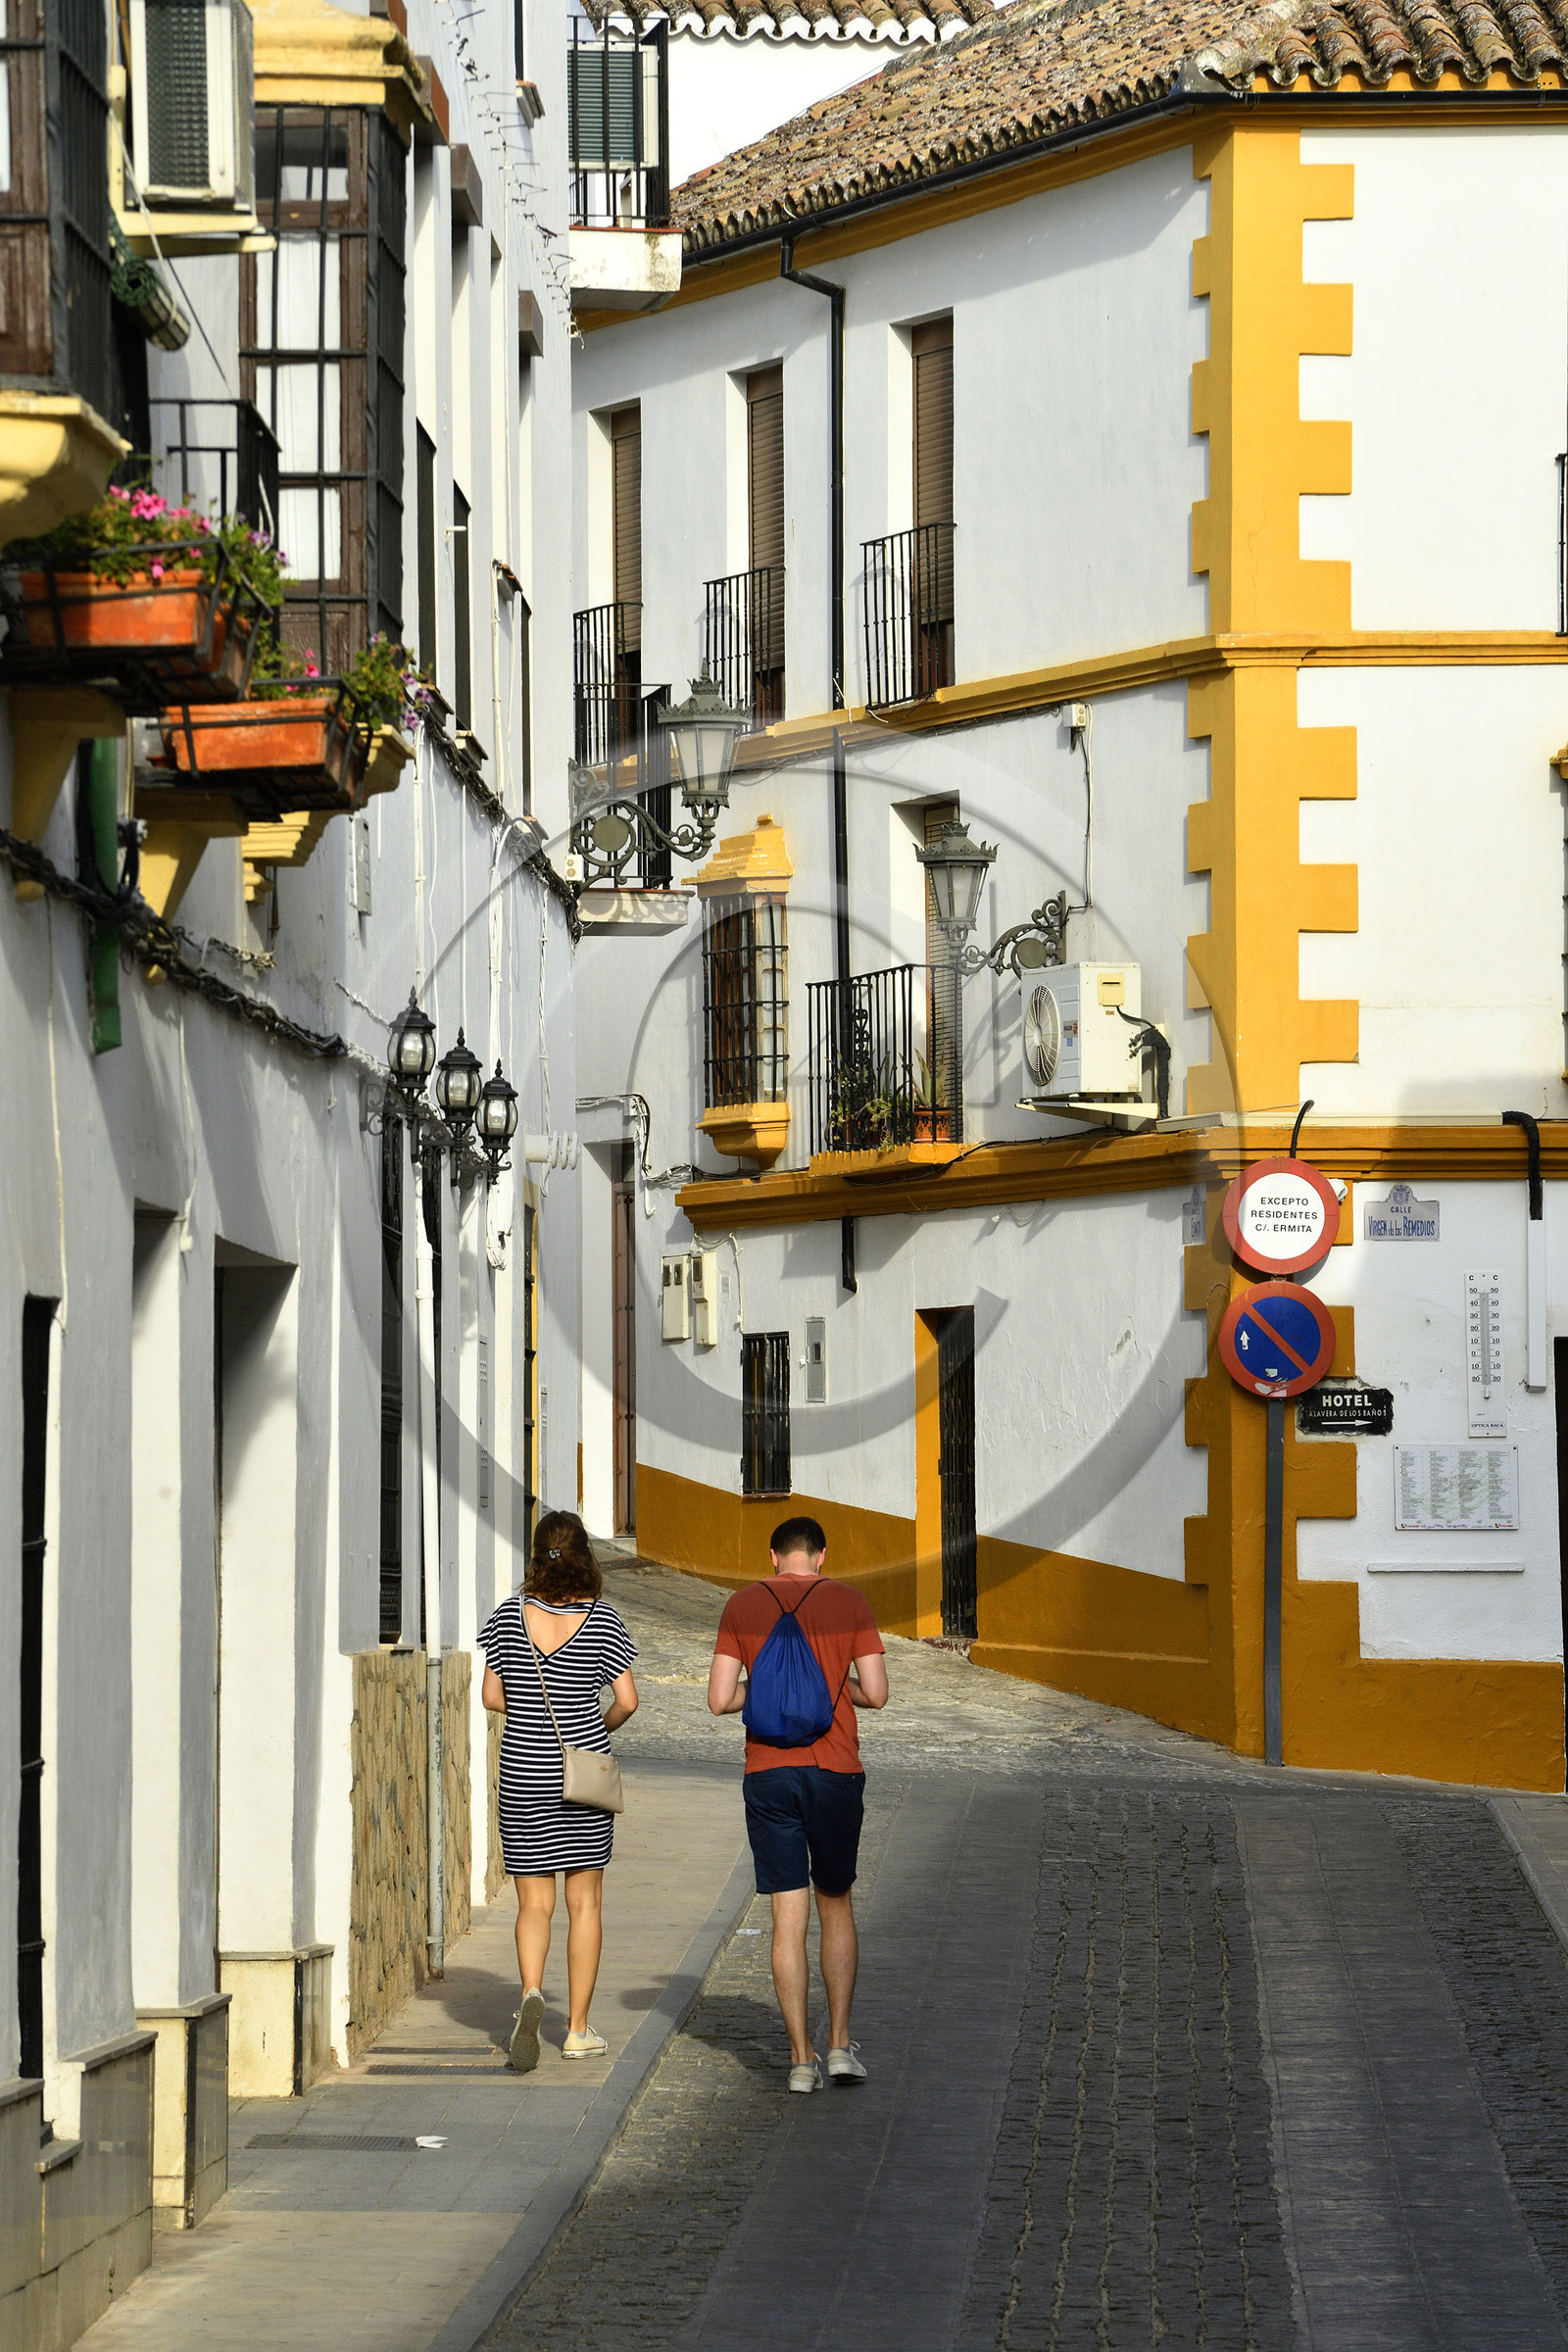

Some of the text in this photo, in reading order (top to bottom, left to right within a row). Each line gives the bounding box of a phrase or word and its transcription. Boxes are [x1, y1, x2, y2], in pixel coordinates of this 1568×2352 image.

[1260, 1197, 1309, 1206] EXCEPTO
[1250, 1209, 1318, 1220] RESIDENTES
[1273, 1224, 1312, 1233] ERMITA
[1388, 1220, 1395, 1236] de
[1403, 1215, 1436, 1237] REMEDIOS
[1322, 1395, 1372, 1407] HOTEL
[1363, 1408, 1387, 1417] BAÑOS
